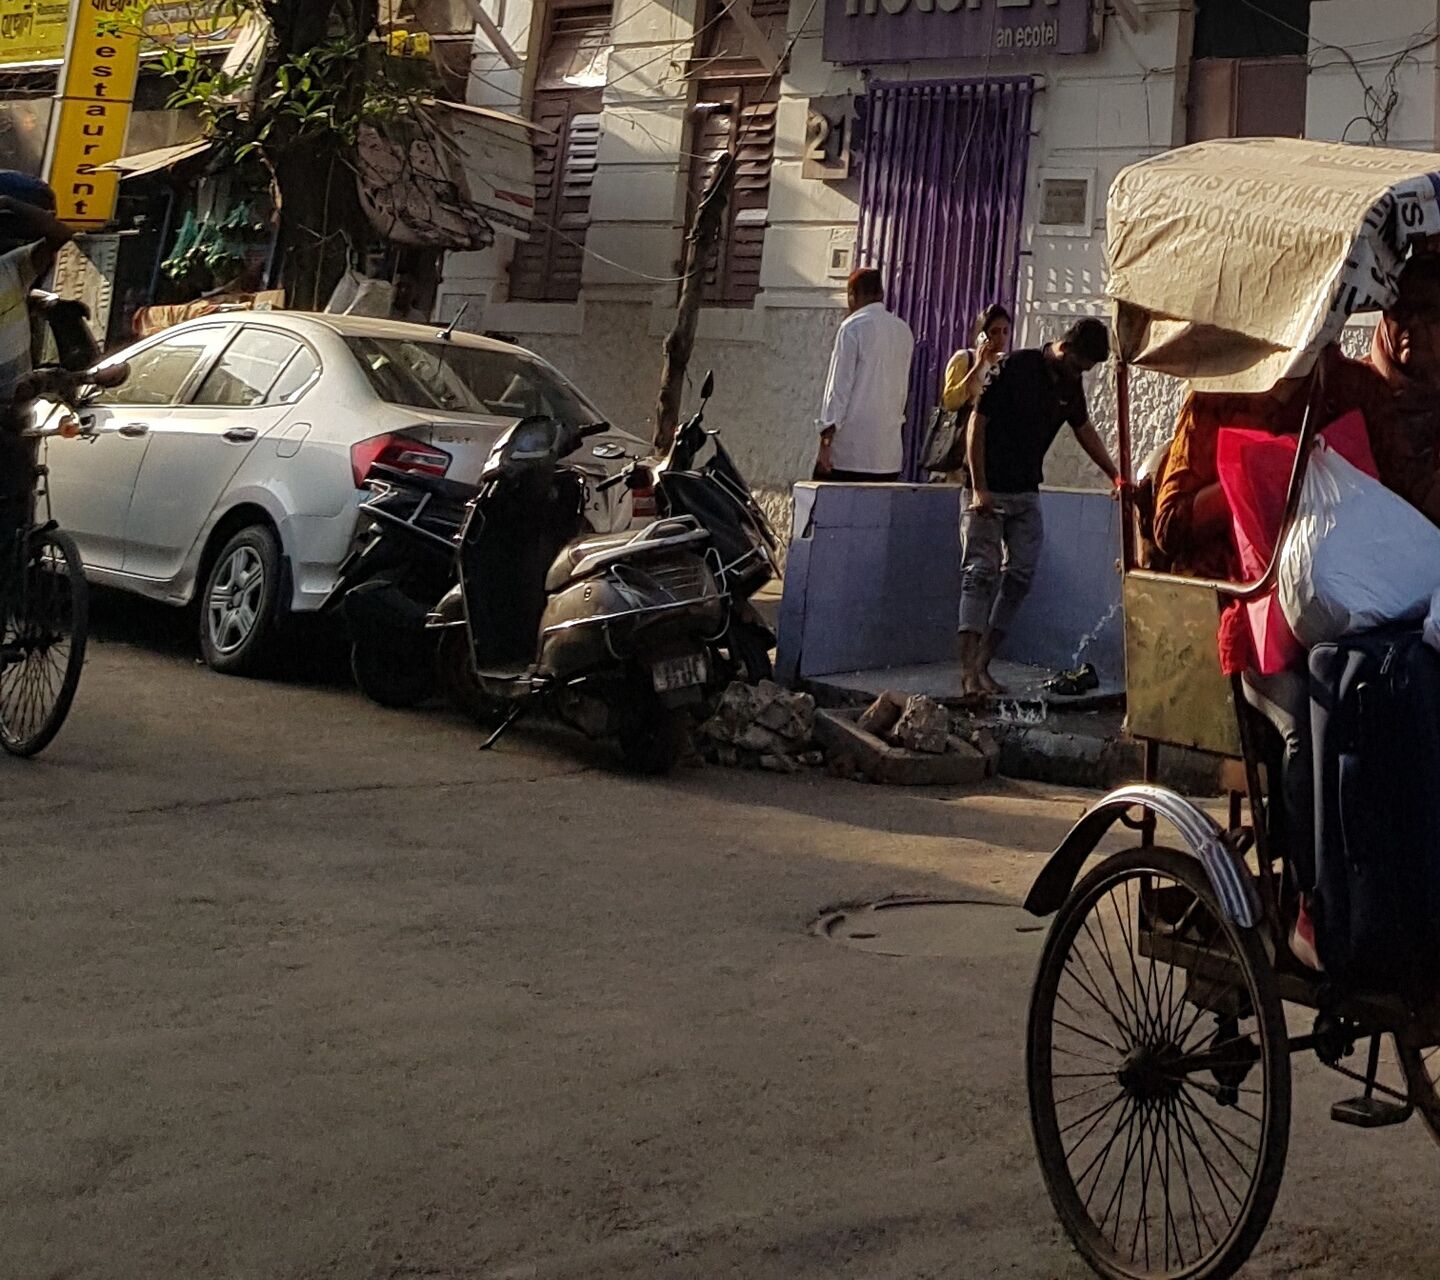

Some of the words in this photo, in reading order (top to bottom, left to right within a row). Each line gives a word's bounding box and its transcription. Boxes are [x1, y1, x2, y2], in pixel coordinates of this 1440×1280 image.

[996, 28, 1014, 49] an
[1016, 19, 1059, 48] ecotel
[807, 110, 849, 160] 21
